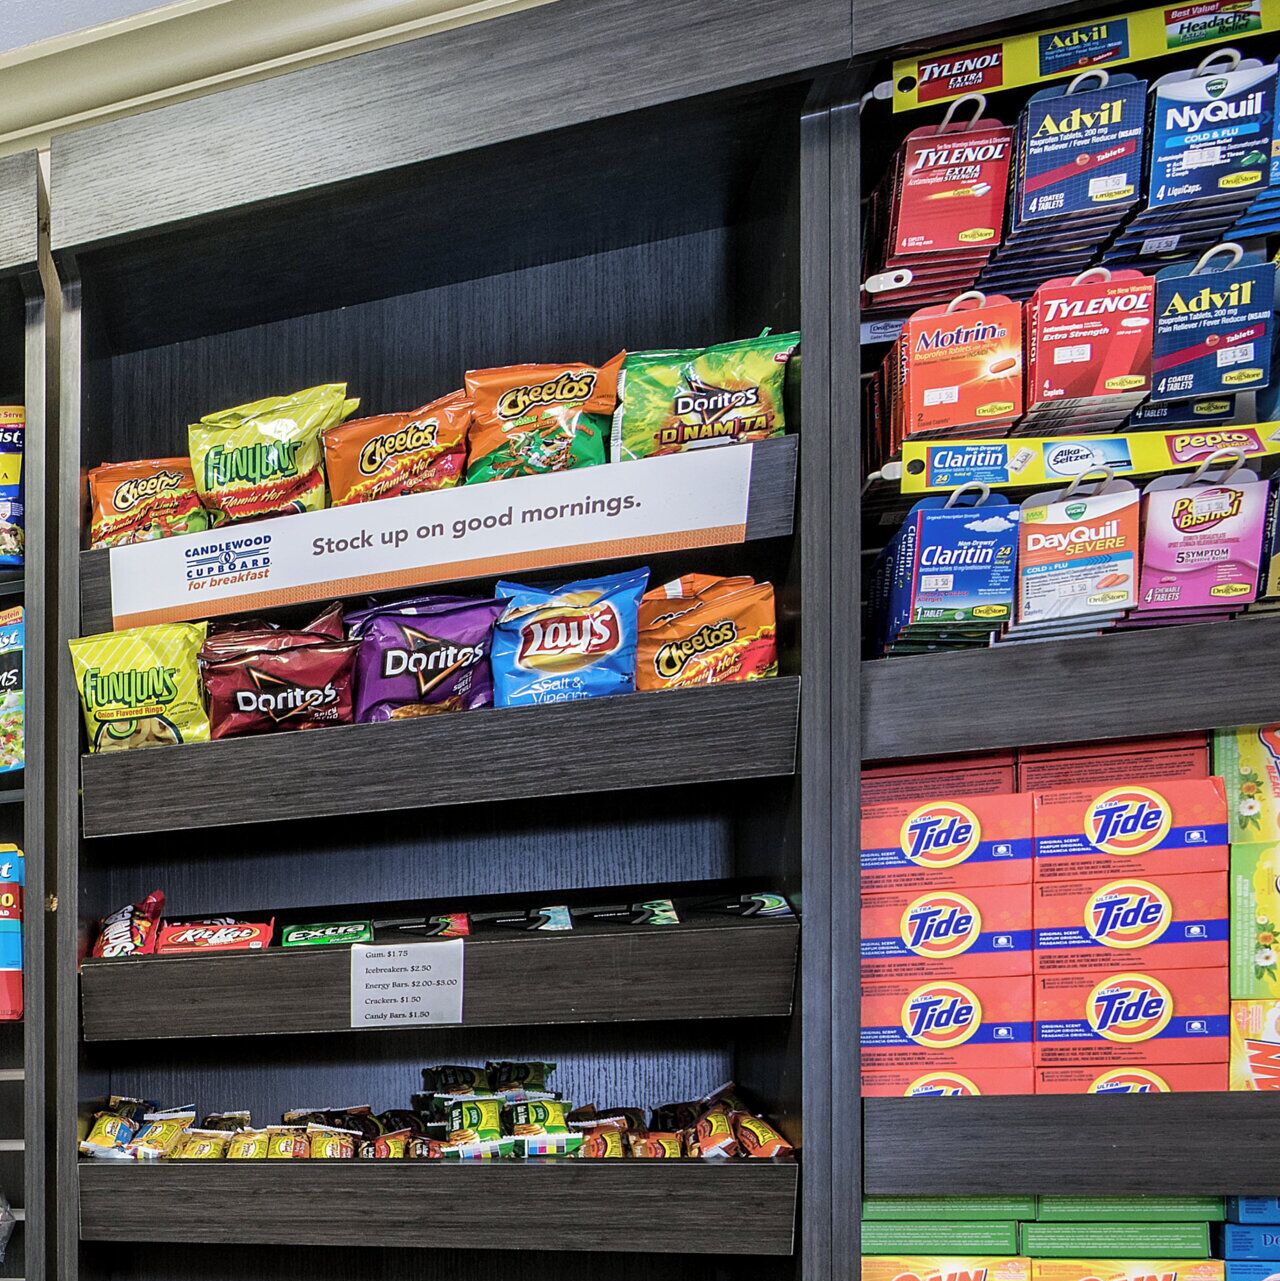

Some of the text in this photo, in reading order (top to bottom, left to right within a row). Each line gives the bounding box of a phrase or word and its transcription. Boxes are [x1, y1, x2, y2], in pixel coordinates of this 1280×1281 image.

[1048, 24, 1107, 50] Advil
[1178, 12, 1250, 35] Headache
[1035, 100, 1125, 138] Advil
[1166, 94, 1265, 132] NyQuil
[913, 144, 1008, 174] TYLENOL
[916, 322, 998, 353] Motrin
[498, 370, 597, 419] Cheetos
[677, 389, 757, 415] Doritos
[360, 422, 438, 476] Cheetos
[932, 449, 1005, 469] Claritin
[205, 439, 302, 490] FUNYUNS
[312, 495, 641, 556] Stock up on good mornings.
[1026, 520, 1118, 552] DayQuil
[185, 534, 272, 558] CANDLEWOOD
[920, 545, 995, 567] Claritin
[1065, 535, 1126, 556] SEVERE
[186, 557, 271, 578] CUPBOARD
[188, 569, 270, 591] for breakfast
[520, 607, 620, 655] Lay's
[83, 666, 179, 710] FUNYUNS
[237, 684, 335, 714] Doritos
[909, 816, 973, 858] Tide
[1095, 803, 1163, 847] Tide
[288, 924, 364, 942] Extra
[365, 966, 408, 974] Icebreakers.
